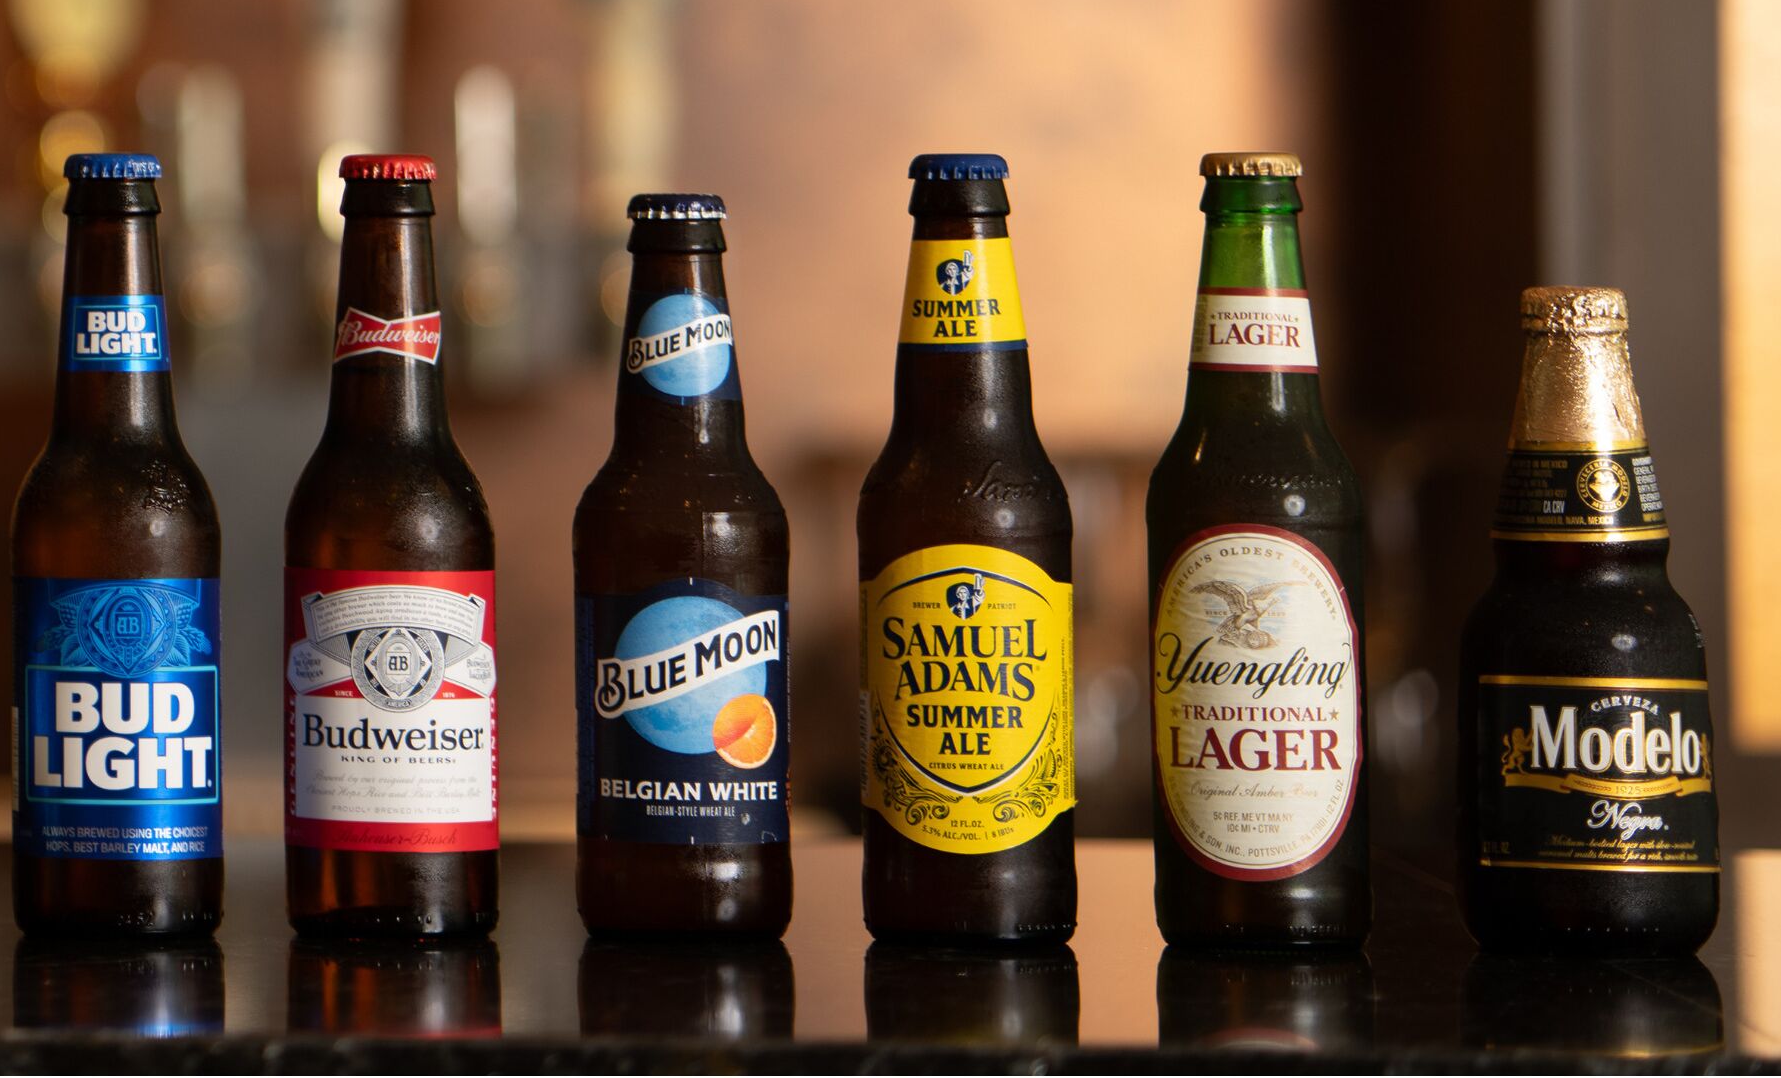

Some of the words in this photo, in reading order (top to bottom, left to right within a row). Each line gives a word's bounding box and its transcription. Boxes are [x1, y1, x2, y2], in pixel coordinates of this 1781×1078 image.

[912, 299, 1001, 318] SUMMER
[1217, 312, 1295, 323] TRADITIONAL
[87, 311, 146, 333] BUD
[933, 319, 978, 337] ALE
[76, 332, 156, 354] LIGHT
[337, 320, 440, 346] Budweiser
[1208, 323, 1301, 348] LAGER
[627, 333, 680, 370] BLUE
[685, 320, 731, 348] MOON
[1542, 500, 1552, 514] CA
[1553, 501, 1565, 514] CRV
[1167, 554, 1212, 616] AMERICA'S
[1220, 546, 1285, 561] OLDEST
[882, 616, 1047, 661] SAMUEL
[598, 653, 686, 712] BLUE
[694, 619, 777, 679] MOON
[1156, 632, 1352, 700] Yuengling
[894, 660, 1036, 702] ADAMS
[334, 689, 354, 697] SINCE
[55, 681, 195, 735] BUD
[1181, 704, 1327, 723] TRADITIONAL
[1591, 695, 1660, 715] CERVEZA
[906, 704, 1023, 728] SUMMER
[302, 713, 483, 751] Budweiser
[1530, 705, 1701, 774] Modelo
[939, 732, 992, 755] ALE
[1170, 726, 1342, 772] LAGER
[34, 735, 212, 791] LIGHT
[340, 755, 376, 764] KING
[382, 756, 402, 765] OF
[929, 762, 957, 770] CITRUS
[959, 762, 987, 770] WHEAT
[600, 778, 702, 801] BELGIAN
[709, 781, 778, 801] WHITE
[1190, 781, 1238, 801] Original
[1239, 783, 1285, 797] Amber
[1615, 785, 1642, 795] 1925
[332, 804, 371, 815] PROUDLY
[374, 806, 412, 815] BREWED
[646, 804, 698, 817] BELGIAN-STYLE
[699, 804, 723, 817] WHEAT
[724, 805, 735, 817] ALE
[1213, 811, 1222, 821] 5¢
[1242, 812, 1255, 822] ME
[1255, 812, 1266, 822] VT
[1268, 812, 1282, 822] MA
[1326, 804, 1335, 815] 12
[43, 825, 75, 838] ALWAYS
[77, 827, 120, 839] BREWED
[122, 827, 152, 839] USING
[153, 827, 172, 839] THE
[172, 826, 209, 838] CHOICEST
[922, 825, 941, 837] 5.3%
[950, 820, 958, 828] 12
[1227, 823, 1239, 833] 10¢
[1241, 823, 1251, 833] MI
[331, 827, 458, 847] Anheuser-Busch
[1617, 836, 1640, 854] lager
[73, 841, 99, 853] BEST
[101, 842, 141, 854] BARLEY
[142, 842, 171, 855] MALT,
[171, 842, 188, 853] AND
[189, 841, 205, 852] RICE
